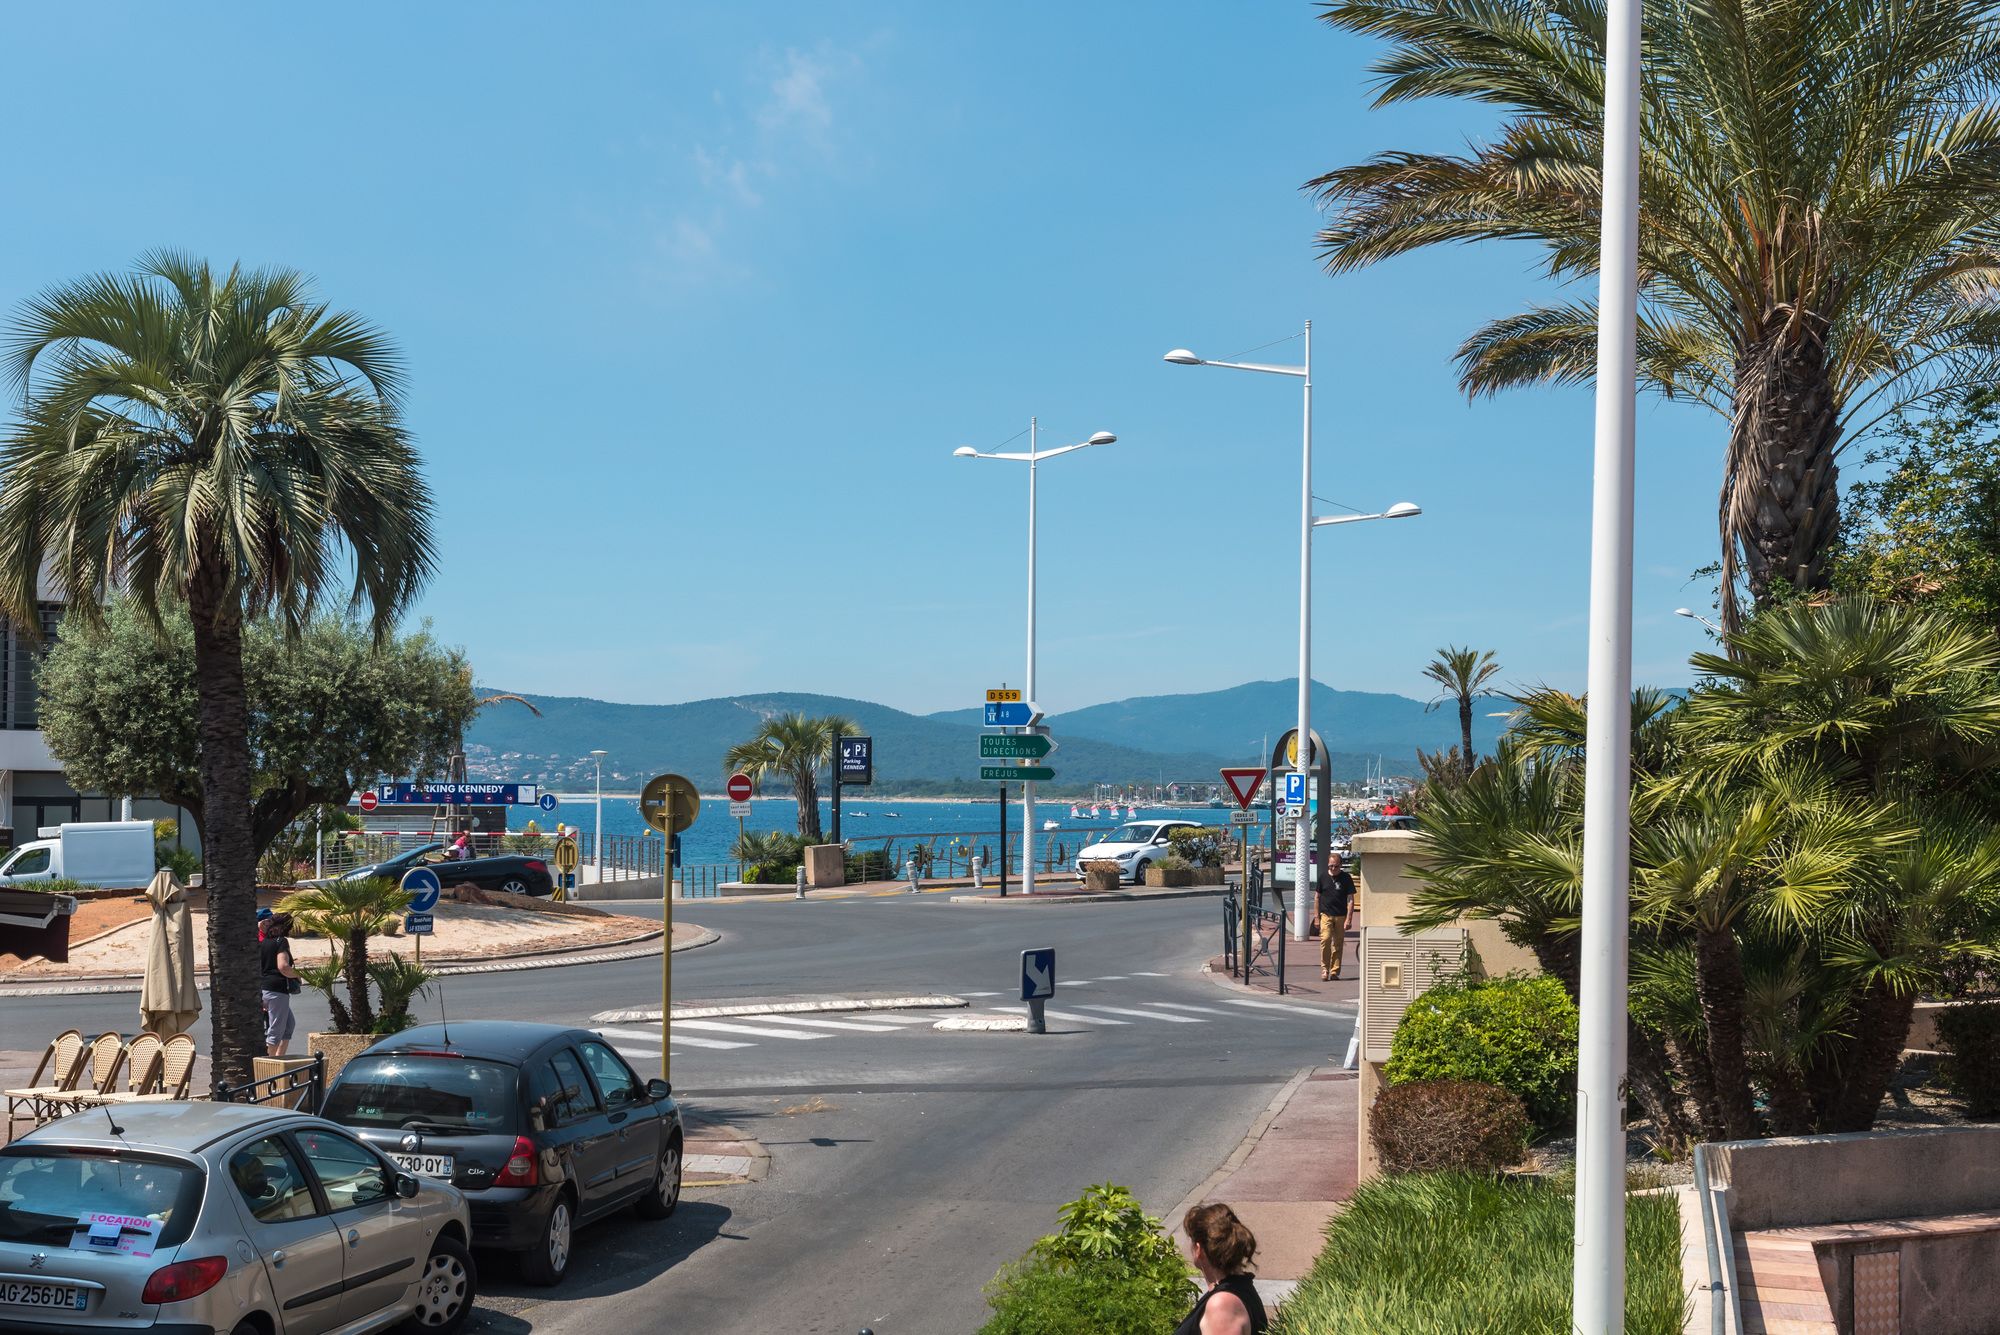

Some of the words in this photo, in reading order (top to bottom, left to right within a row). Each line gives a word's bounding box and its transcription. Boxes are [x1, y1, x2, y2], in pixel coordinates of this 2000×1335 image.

[990, 692, 996, 700] D
[998, 692, 1017, 700] 559
[983, 738, 1017, 746] TOUTES
[983, 747, 1037, 755] DIRECTIONS
[983, 769, 1018, 777] FRÉJUS
[458, 784, 505, 793] KENNEDY
[1290, 776, 1300, 793] P
[90, 1214, 152, 1228] LOCATION
